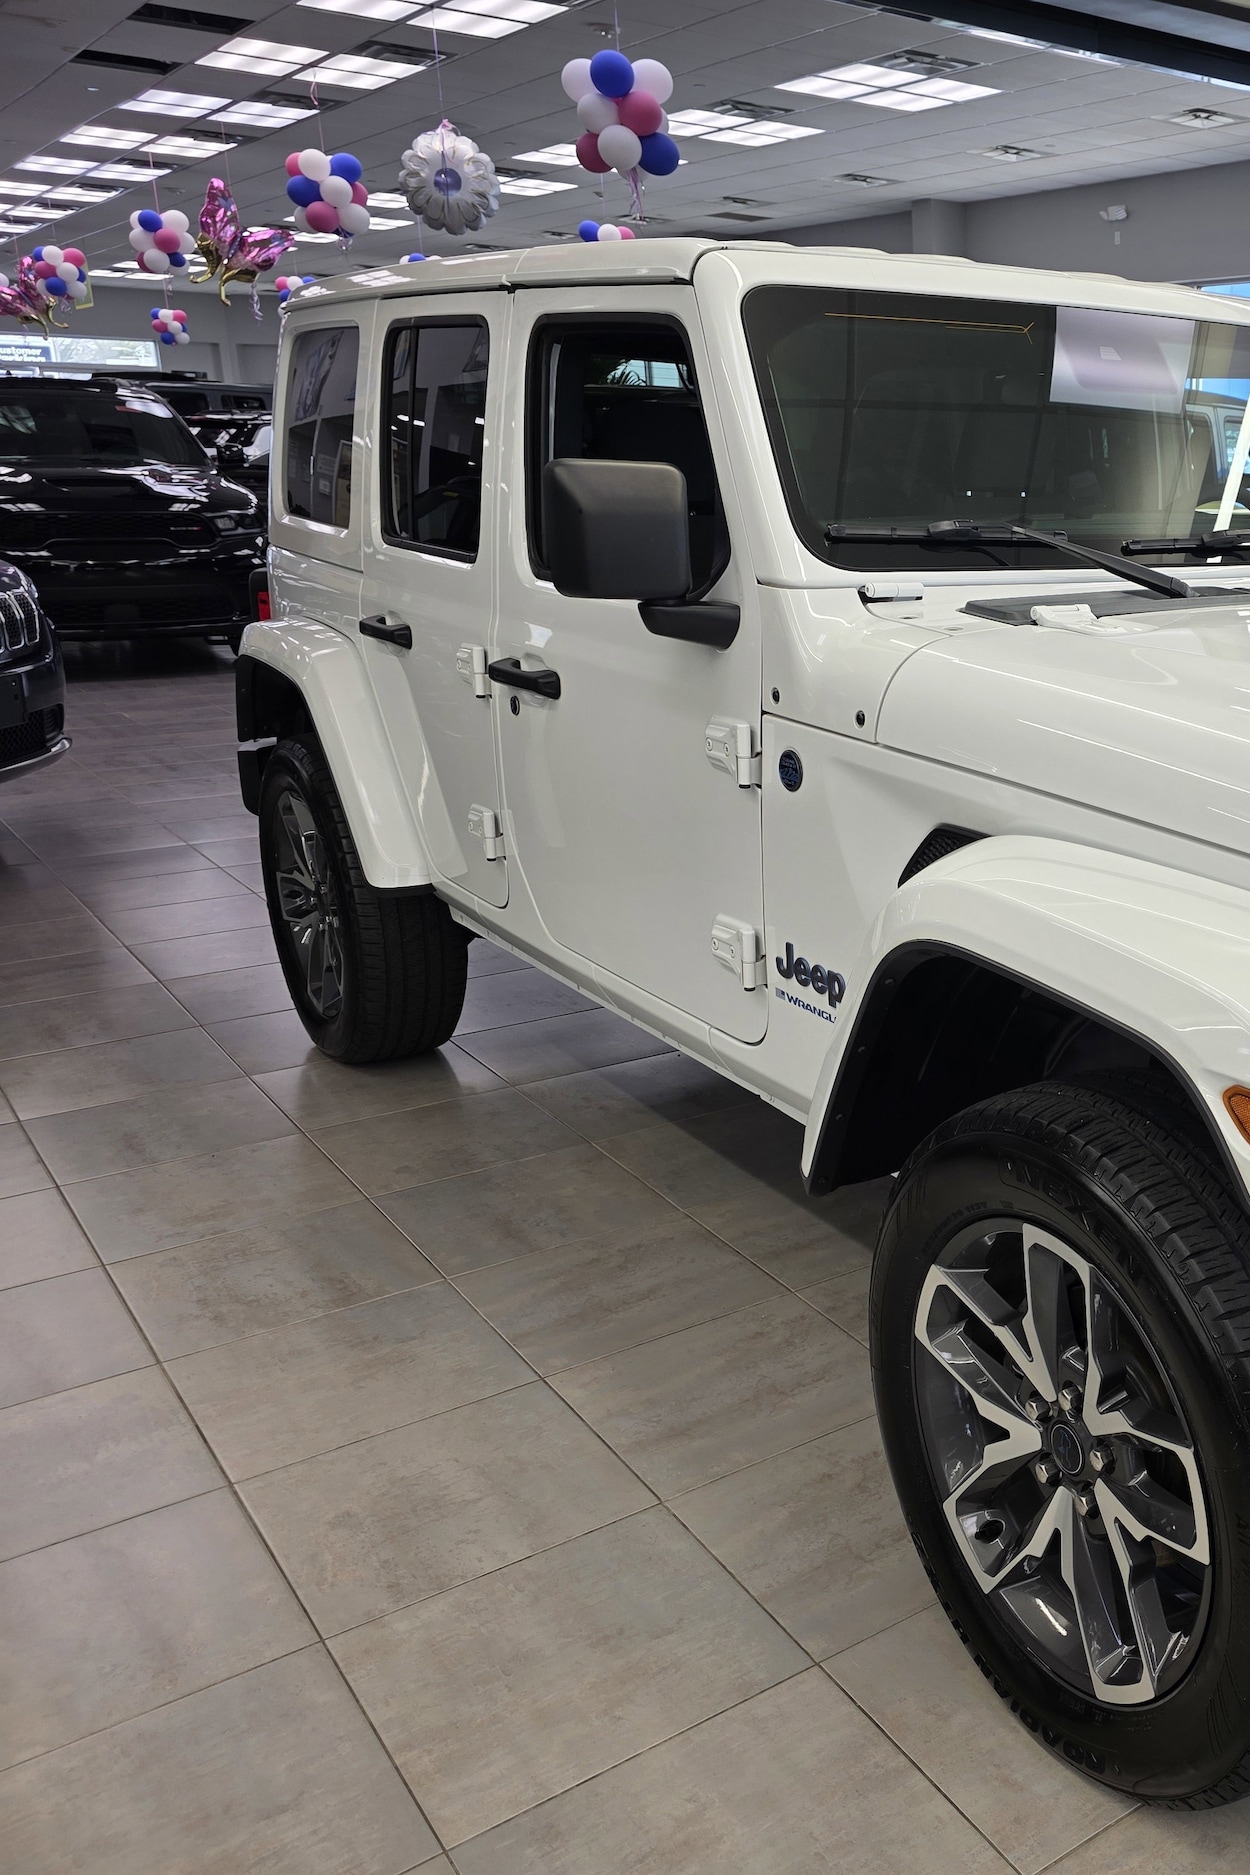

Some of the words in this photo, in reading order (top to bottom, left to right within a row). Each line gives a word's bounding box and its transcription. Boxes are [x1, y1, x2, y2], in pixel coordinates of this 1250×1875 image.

[0, 346, 42, 356] ustomer
[776, 942, 846, 1009] Jeep
[786, 992, 837, 1024] WRANGL
[1014, 1161, 1140, 1284] NEXEN
[974, 1652, 1106, 1775] ROADIAN
